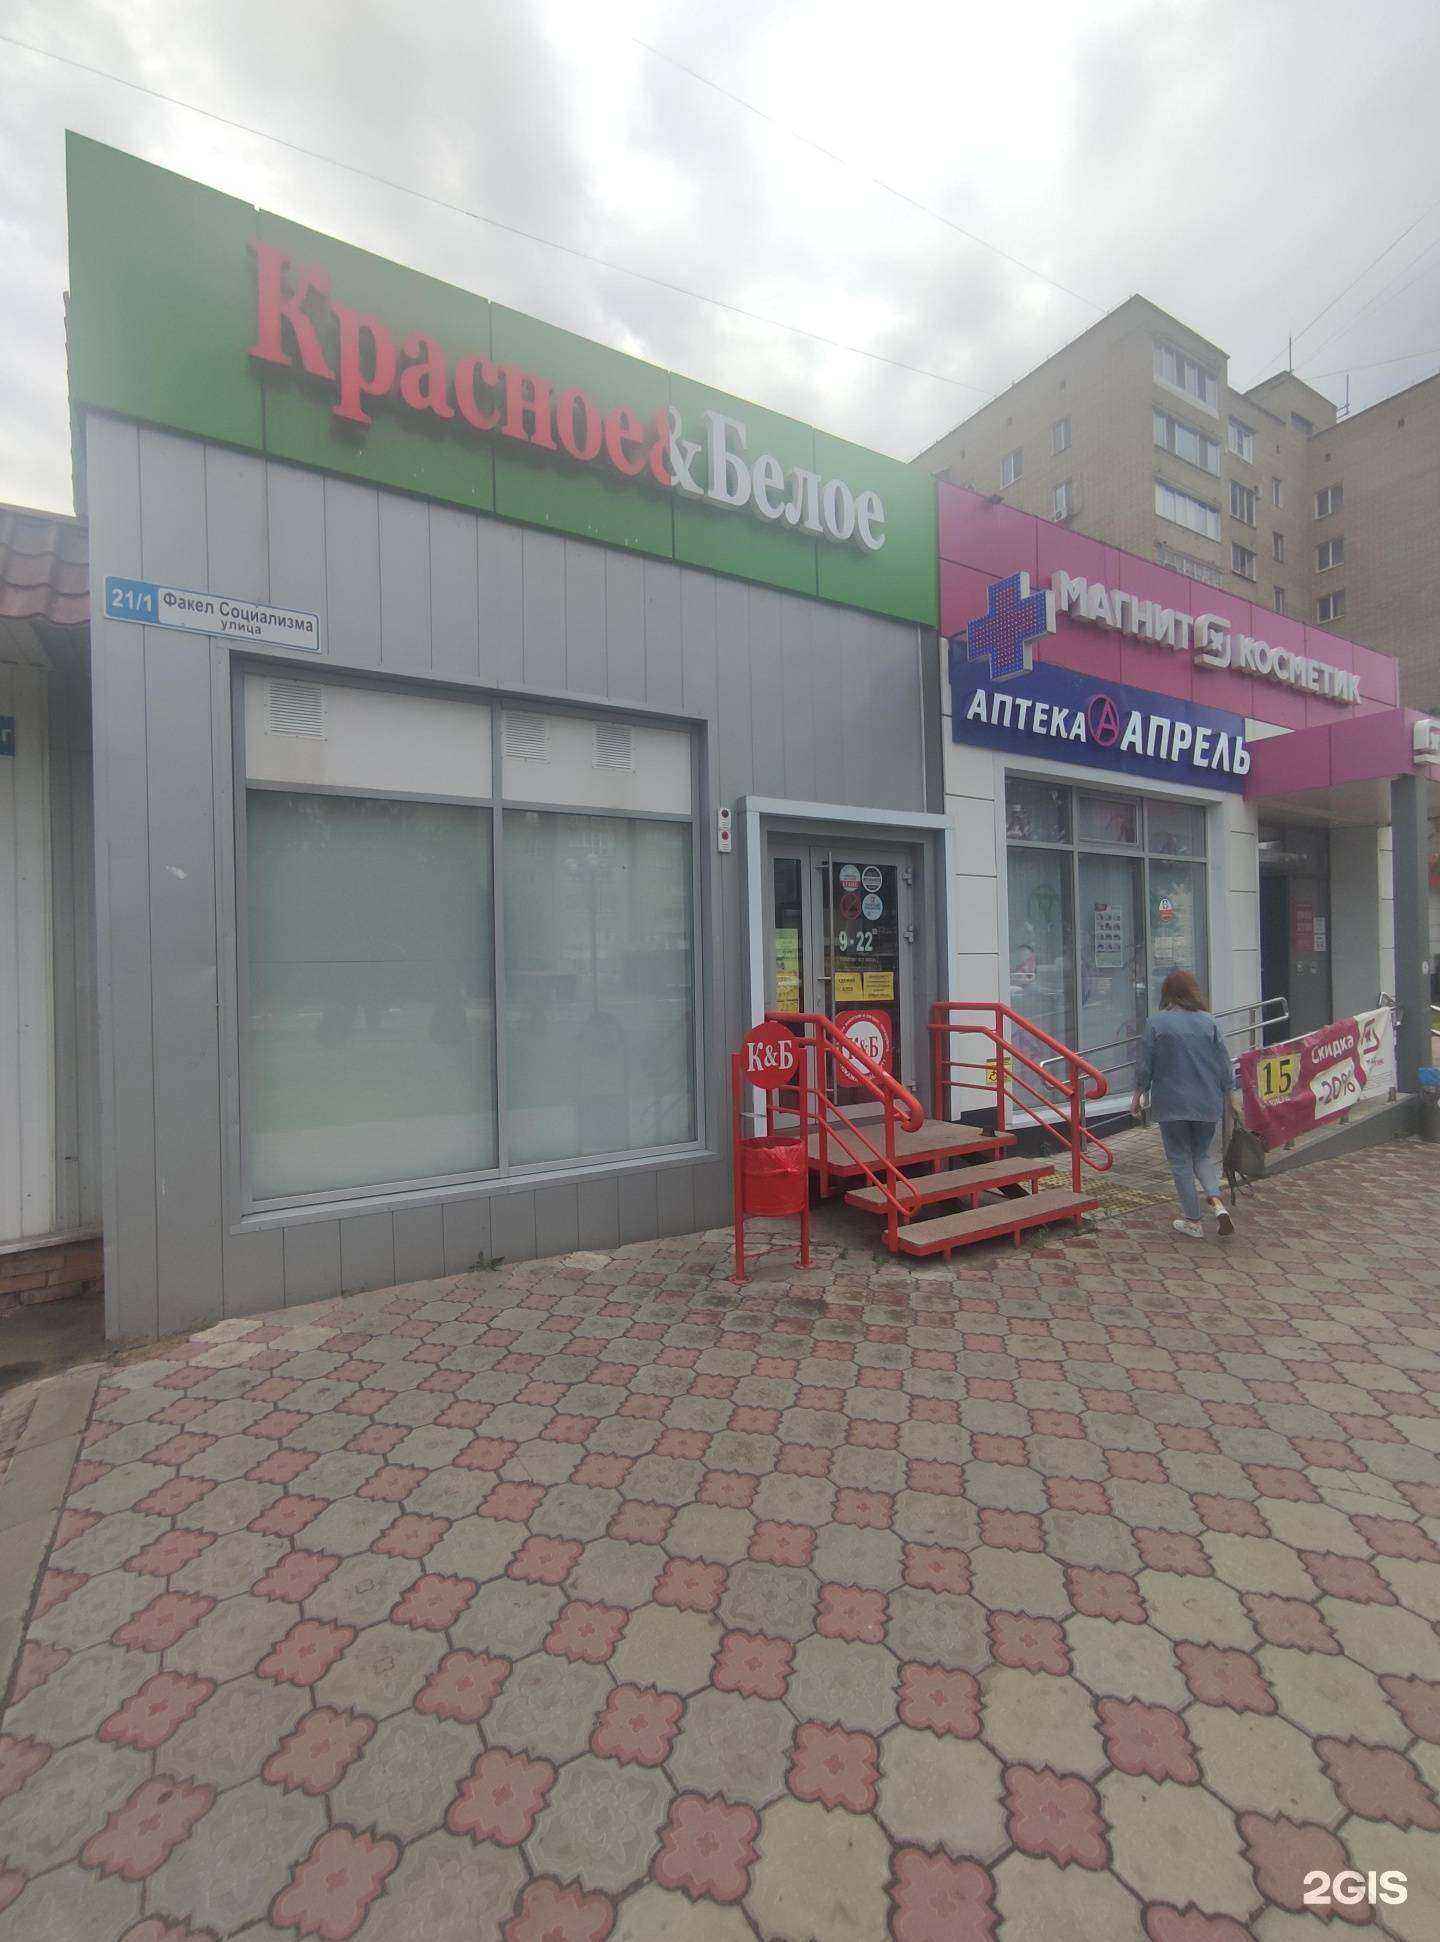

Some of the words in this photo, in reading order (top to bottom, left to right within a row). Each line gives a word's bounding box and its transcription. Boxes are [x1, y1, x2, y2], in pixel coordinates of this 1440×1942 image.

[111, 588, 152, 613] 21/1
[163, 591, 214, 615] Факел
[219, 601, 314, 633] Социализма
[220, 619, 262, 636] улица
[1052, 569, 1194, 650] МАГНИТ
[1235, 635, 1362, 704] КОСМЕТИК
[967, 688, 1087, 744] АПТЕКА
[1120, 711, 1251, 776] АПРЕЛЬ
[746, 1040, 794, 1072] К&Б
[1263, 1059, 1292, 1095] 15
